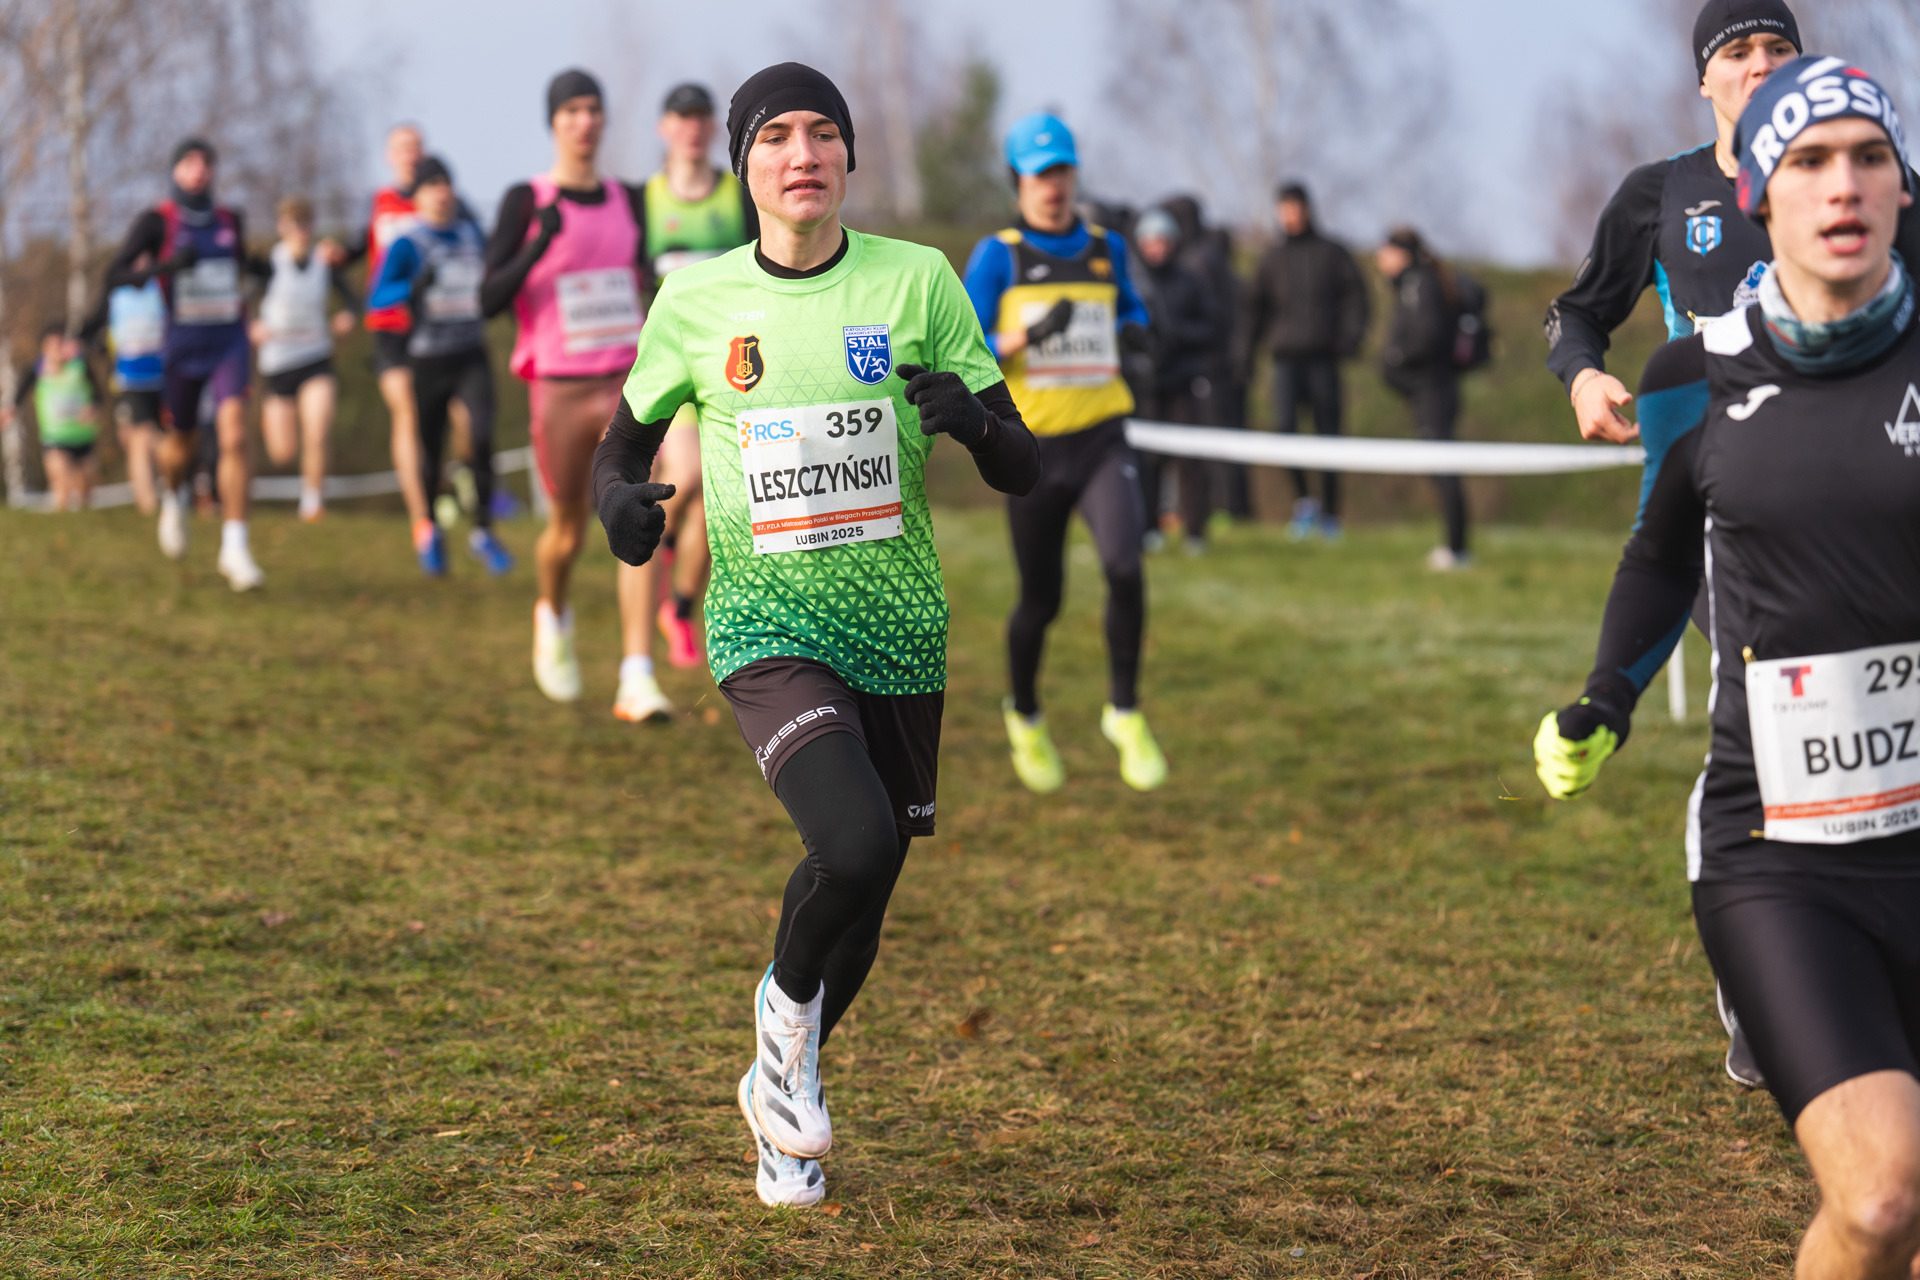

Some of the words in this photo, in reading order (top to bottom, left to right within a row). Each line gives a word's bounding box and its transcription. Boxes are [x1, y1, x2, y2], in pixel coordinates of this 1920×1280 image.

[1708, 30, 1725, 50] RUN
[1724, 19, 1758, 35] YOUR
[1759, 18, 1786, 29] WAY
[748, 106, 767, 132] WAY
[848, 336, 886, 348] STAL
[826, 407, 883, 438] 359
[749, 454, 892, 504] LESZCZYŃSKI
[781, 519, 812, 528] Mistrzostwa
[813, 515, 828, 524] Polski
[835, 512, 860, 521] Biegach
[861, 505, 899, 517] Przełajowych
[795, 531, 829, 545] LUBIN
[831, 526, 864, 540] 2025
[1865, 655, 1920, 695] 29
[1823, 819, 1876, 836] LUBIN
[1880, 805, 1919, 828] 2025
